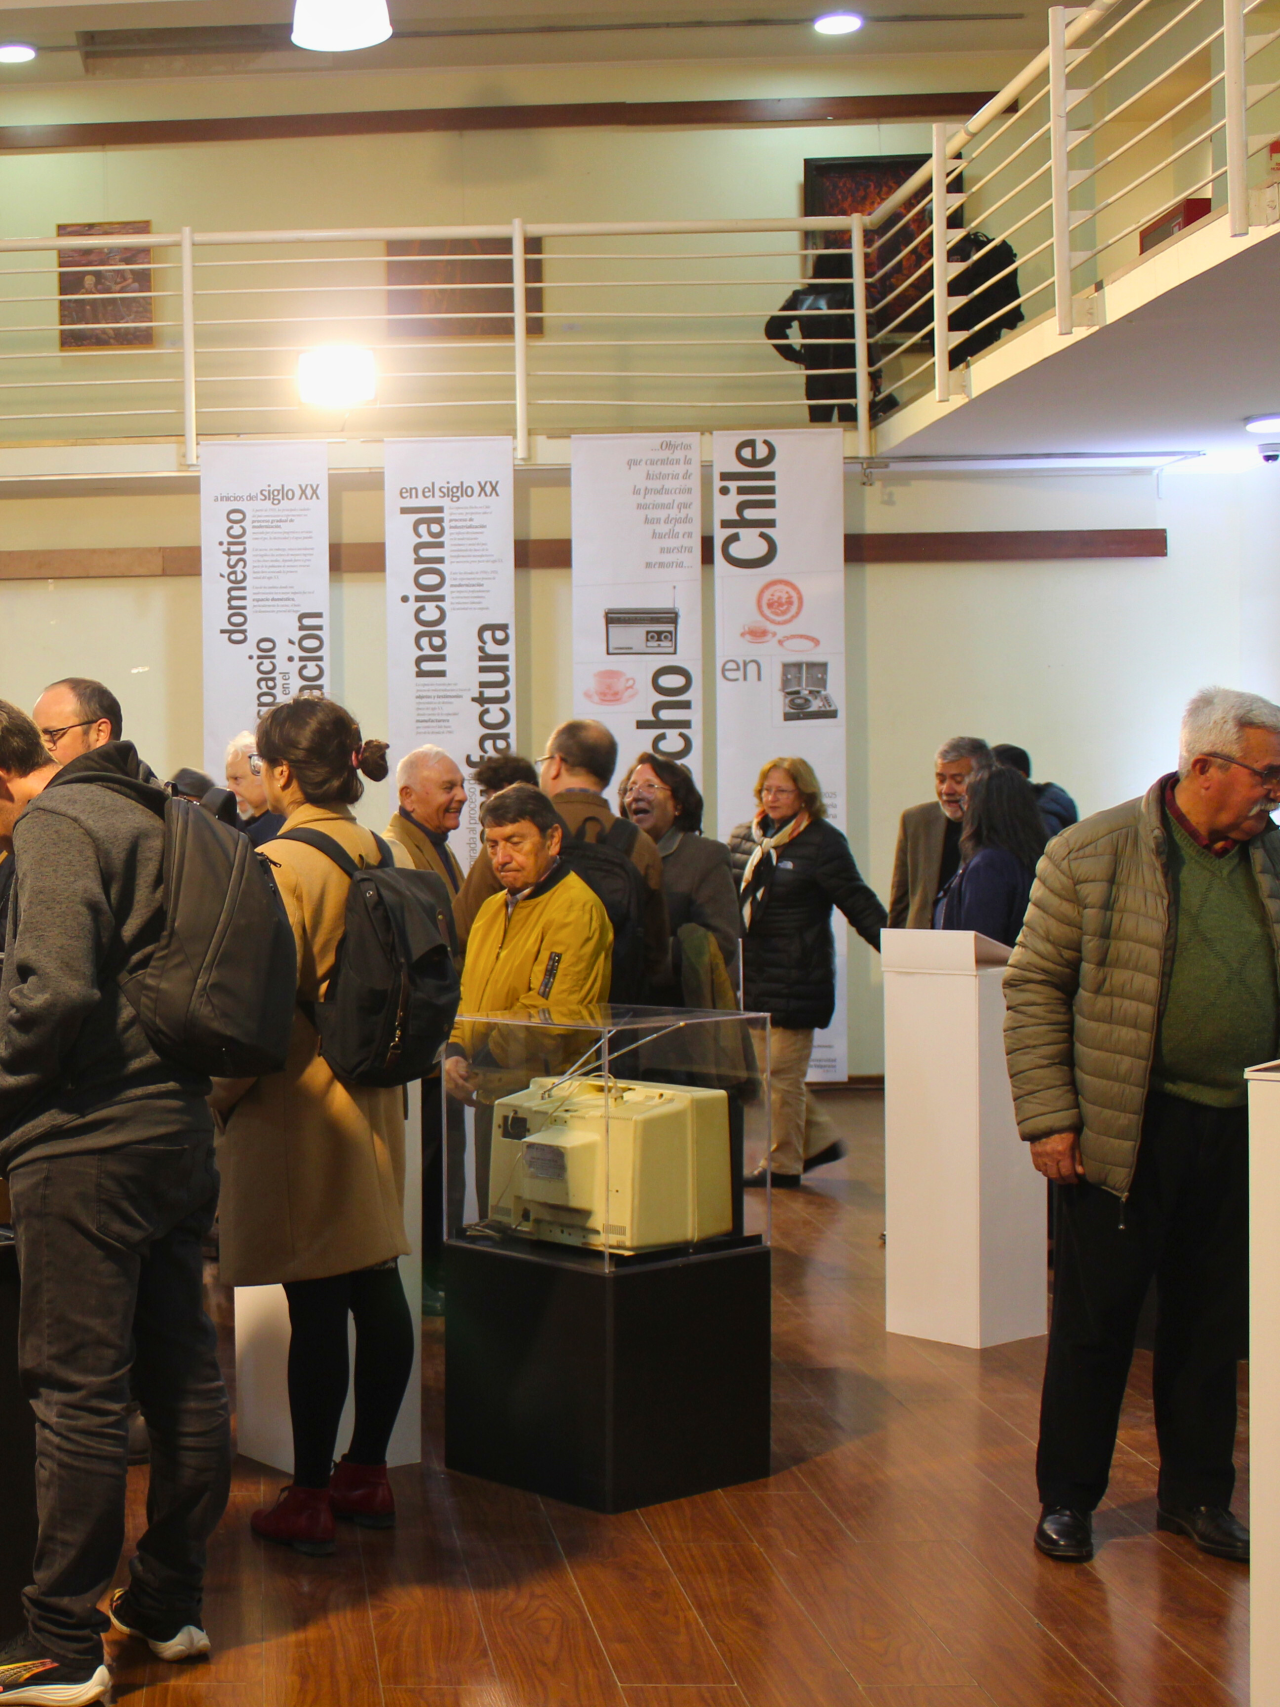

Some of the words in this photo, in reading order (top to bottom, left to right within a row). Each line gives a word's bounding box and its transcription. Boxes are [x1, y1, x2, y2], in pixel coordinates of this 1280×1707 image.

[651, 440, 692, 454] ...Objetos
[627, 458, 642, 470] que
[645, 457, 680, 466] cuentan
[684, 454, 692, 466] la
[645, 470, 680, 481] historia
[682, 469, 693, 480] de
[219, 493, 245, 502] inicios
[246, 493, 258, 501] del
[260, 484, 296, 506] siglo
[298, 484, 320, 500] XX
[399, 486, 418, 499] en
[422, 482, 435, 499] el
[439, 481, 474, 503] siglo
[478, 480, 500, 497] XX
[632, 485, 641, 496] la
[643, 484, 692, 499] producción
[636, 499, 675, 510] nacional
[677, 501, 693, 514] que
[719, 438, 778, 569] Chile
[644, 514, 661, 525] han
[664, 514, 693, 528] dejado
[652, 528, 679, 540] huella
[682, 531, 693, 539] en
[659, 545, 693, 554] nuestra
[645, 559, 693, 569] memoria...
[218, 508, 248, 644] doméstico
[400, 505, 447, 678] nacional
[287, 612, 324, 696] ación
[279, 672, 290, 681] el
[721, 657, 762, 682] en
[248, 637, 283, 720] pacio
[282, 683, 290, 695] en
[636, 665, 693, 776] cho
[468, 787, 480, 825] proceso
[466, 827, 477, 835] al
